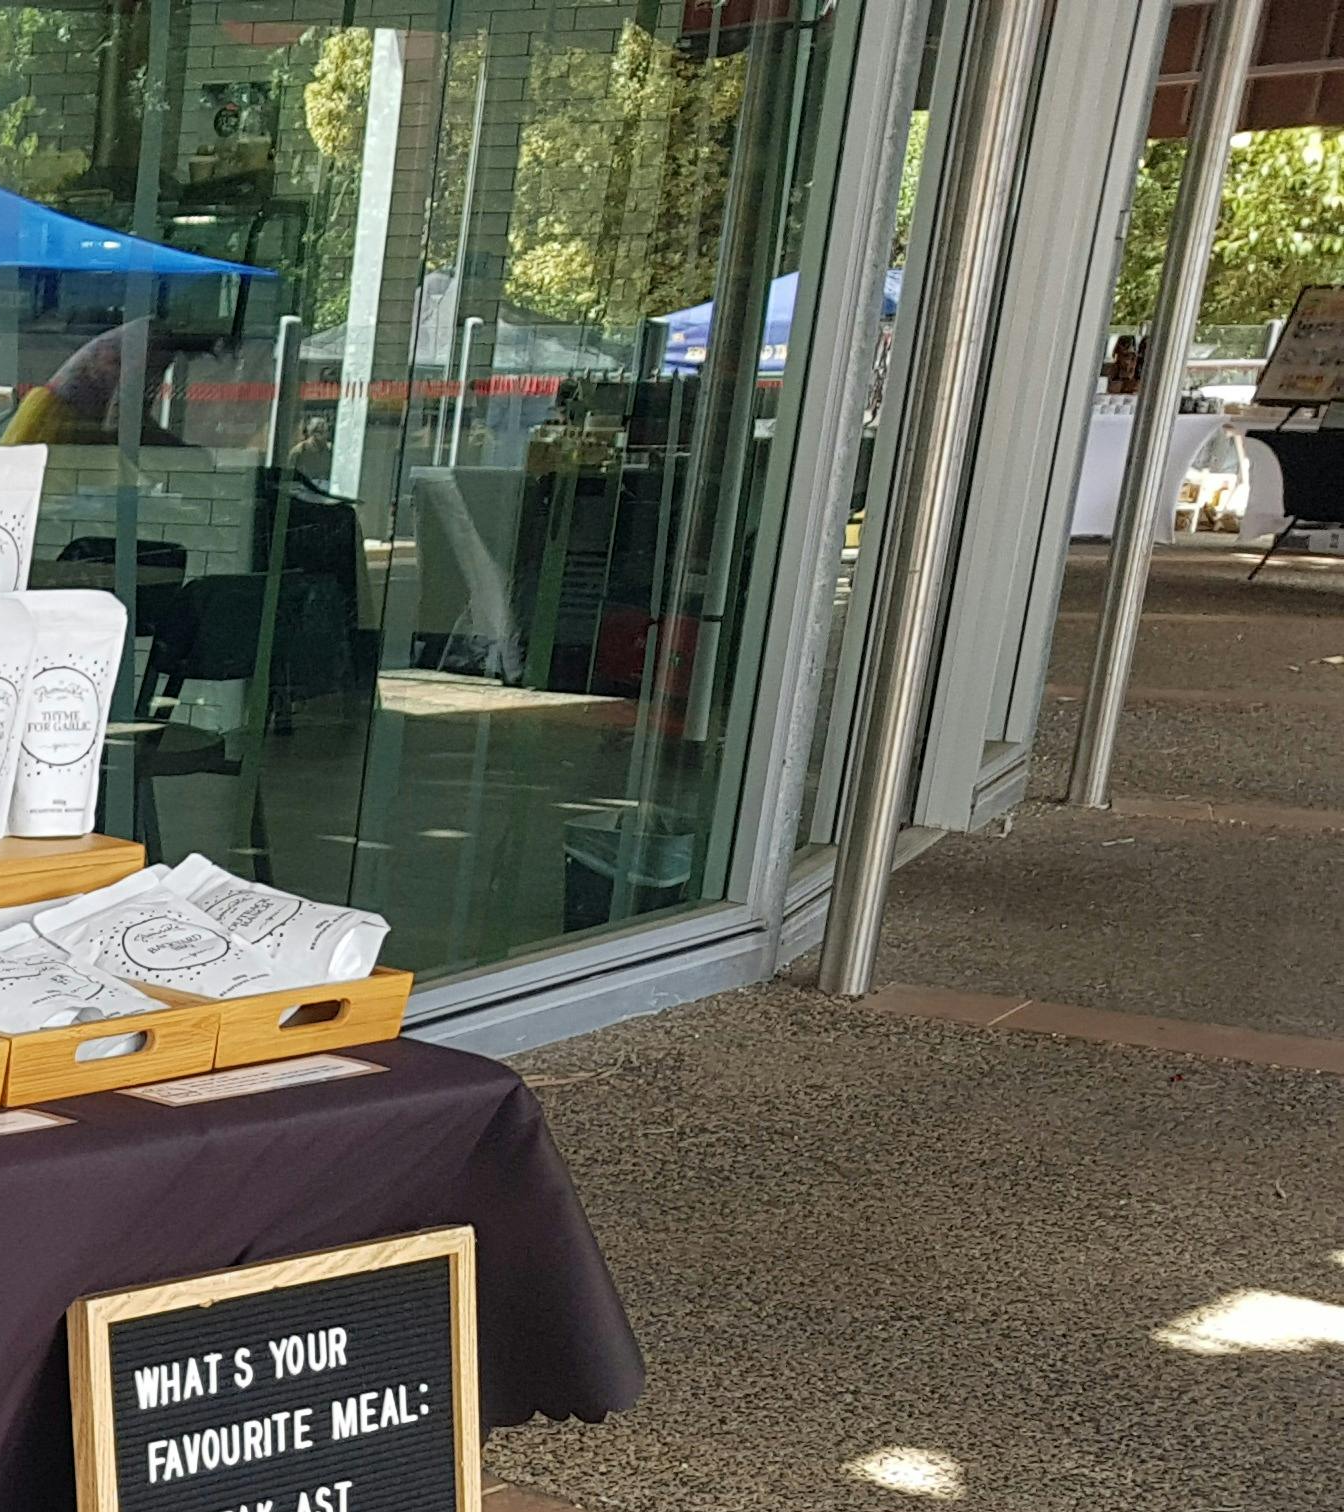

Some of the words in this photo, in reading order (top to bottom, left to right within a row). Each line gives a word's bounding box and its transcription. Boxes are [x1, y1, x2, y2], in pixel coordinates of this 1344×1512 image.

[27, 721, 50, 732] FOR
[53, 720, 91, 732] GARLIC
[42, 711, 80, 722] THYME
[135, 1353, 222, 1409] WHAT
[269, 1327, 347, 1379] YOUR
[148, 1409, 313, 1483] FAVOURITE
[332, 1384, 428, 1440] MEAL:
